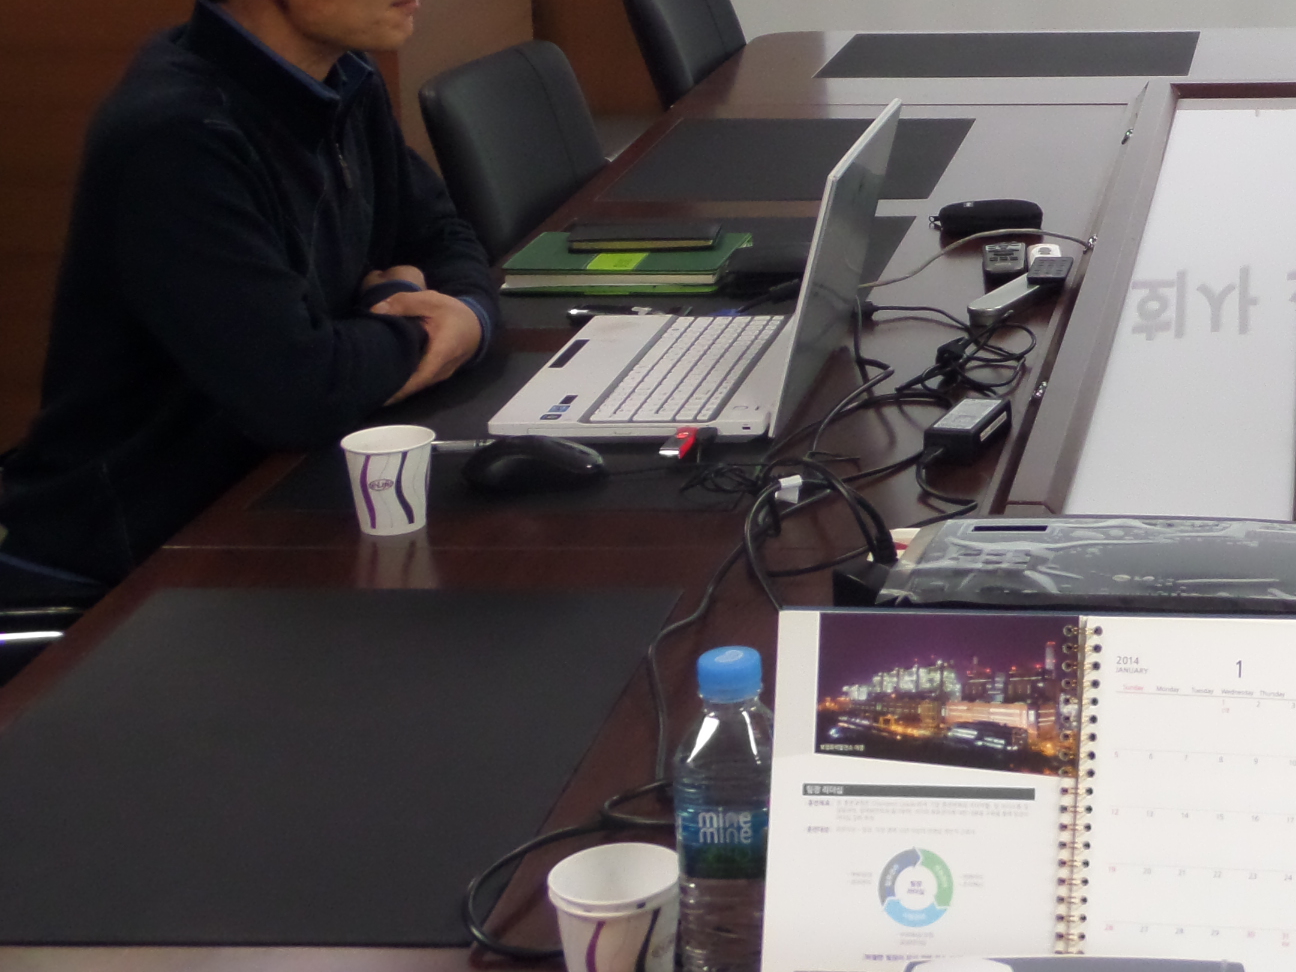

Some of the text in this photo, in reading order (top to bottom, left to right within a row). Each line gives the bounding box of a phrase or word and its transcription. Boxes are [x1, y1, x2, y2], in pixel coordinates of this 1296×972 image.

[1116, 656, 1139, 665] 2014
[1115, 666, 1149, 674] JANUARY
[1236, 660, 1243, 678] 1
[1156, 685, 1180, 694] Monday
[1191, 687, 1214, 696] Tuesday
[1259, 690, 1285, 699] Thursday
[699, 827, 753, 844] mine
